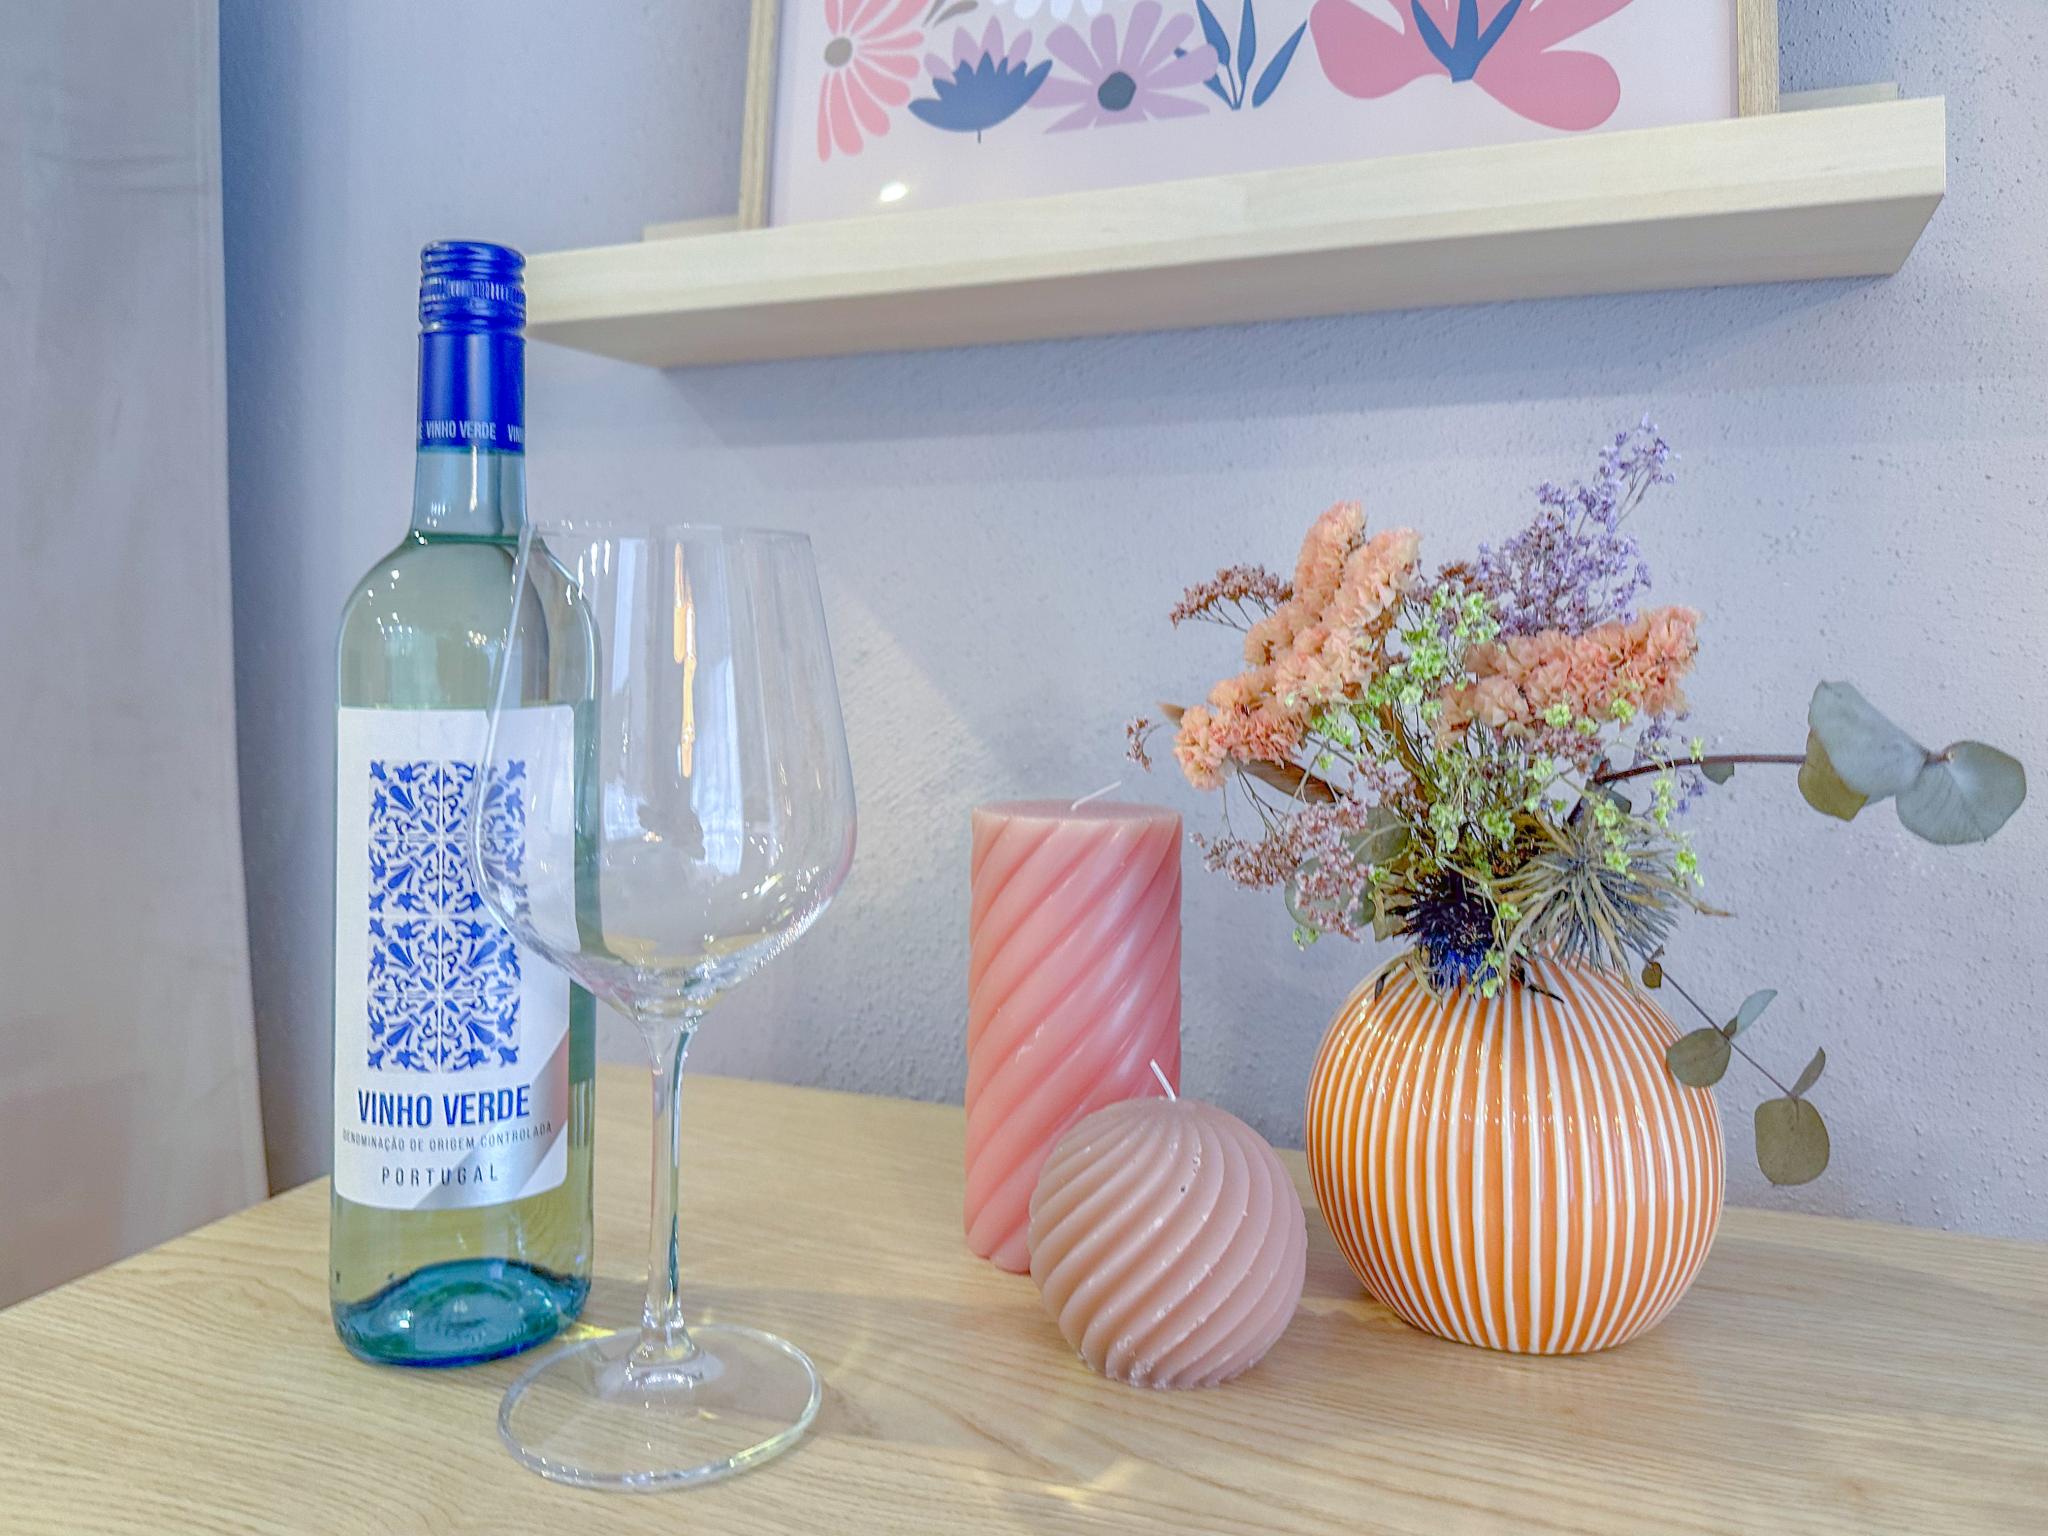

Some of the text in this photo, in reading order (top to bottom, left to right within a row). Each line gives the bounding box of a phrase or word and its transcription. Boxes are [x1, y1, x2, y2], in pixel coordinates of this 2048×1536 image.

[426, 419, 457, 439] VINHO
[459, 419, 496, 441] VERDE
[358, 1083, 531, 1128] VINHO VERDE
[409, 1138, 423, 1152] DE
[429, 1136, 475, 1152] ORIGEM
[480, 1121, 553, 1148] CONTROLADA
[380, 1163, 498, 1187] PORTUGAL
